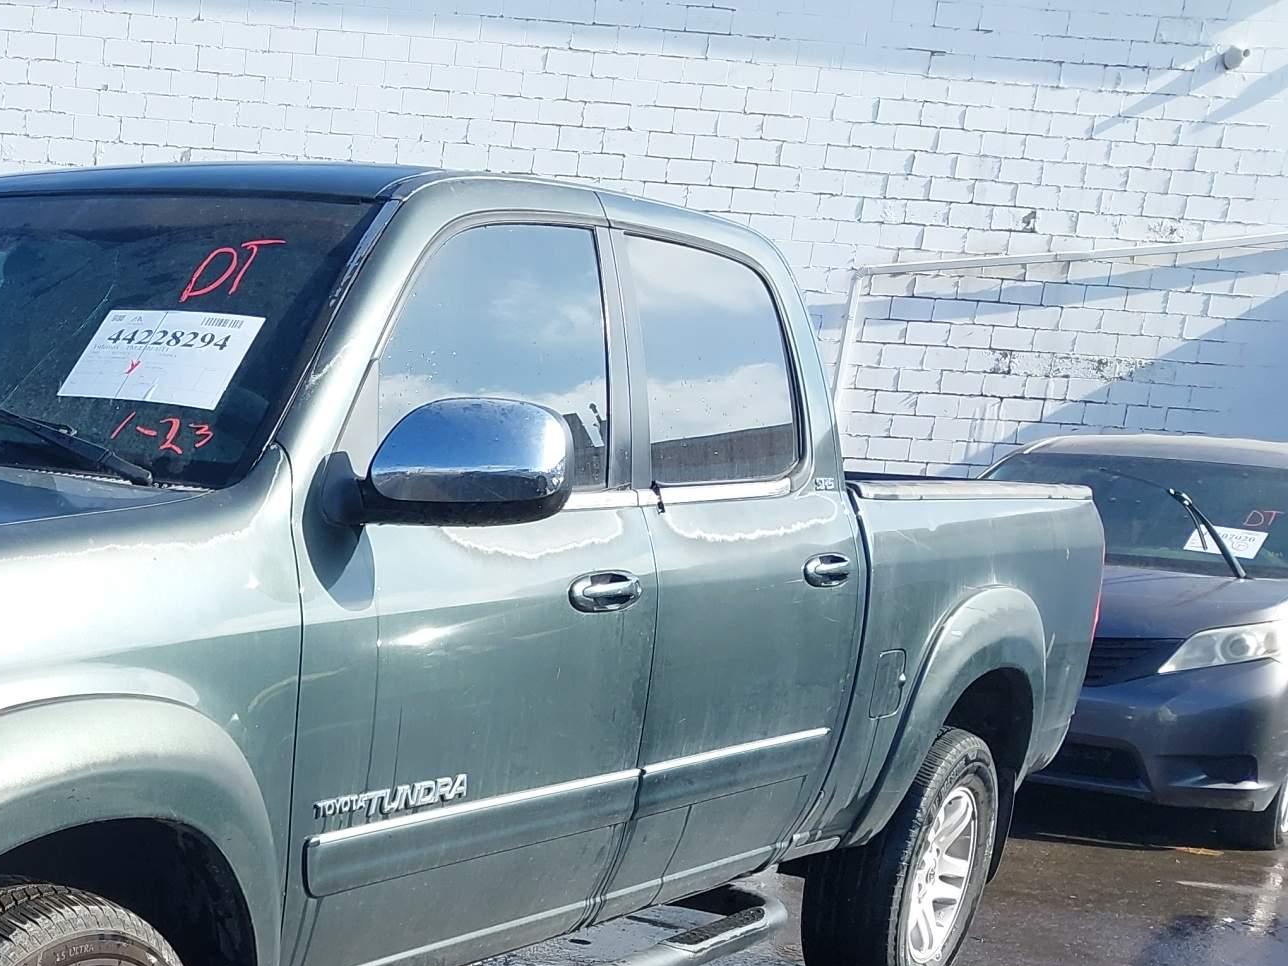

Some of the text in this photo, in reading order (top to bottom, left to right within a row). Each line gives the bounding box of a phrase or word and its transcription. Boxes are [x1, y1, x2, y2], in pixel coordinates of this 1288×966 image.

[179, 239, 287, 303] DT
[107, 328, 232, 351] 44228294
[110, 411, 214, 455] 1-23
[1243, 509, 1285, 527] DT
[314, 773, 469, 819] TOYOTA TUNDRA
